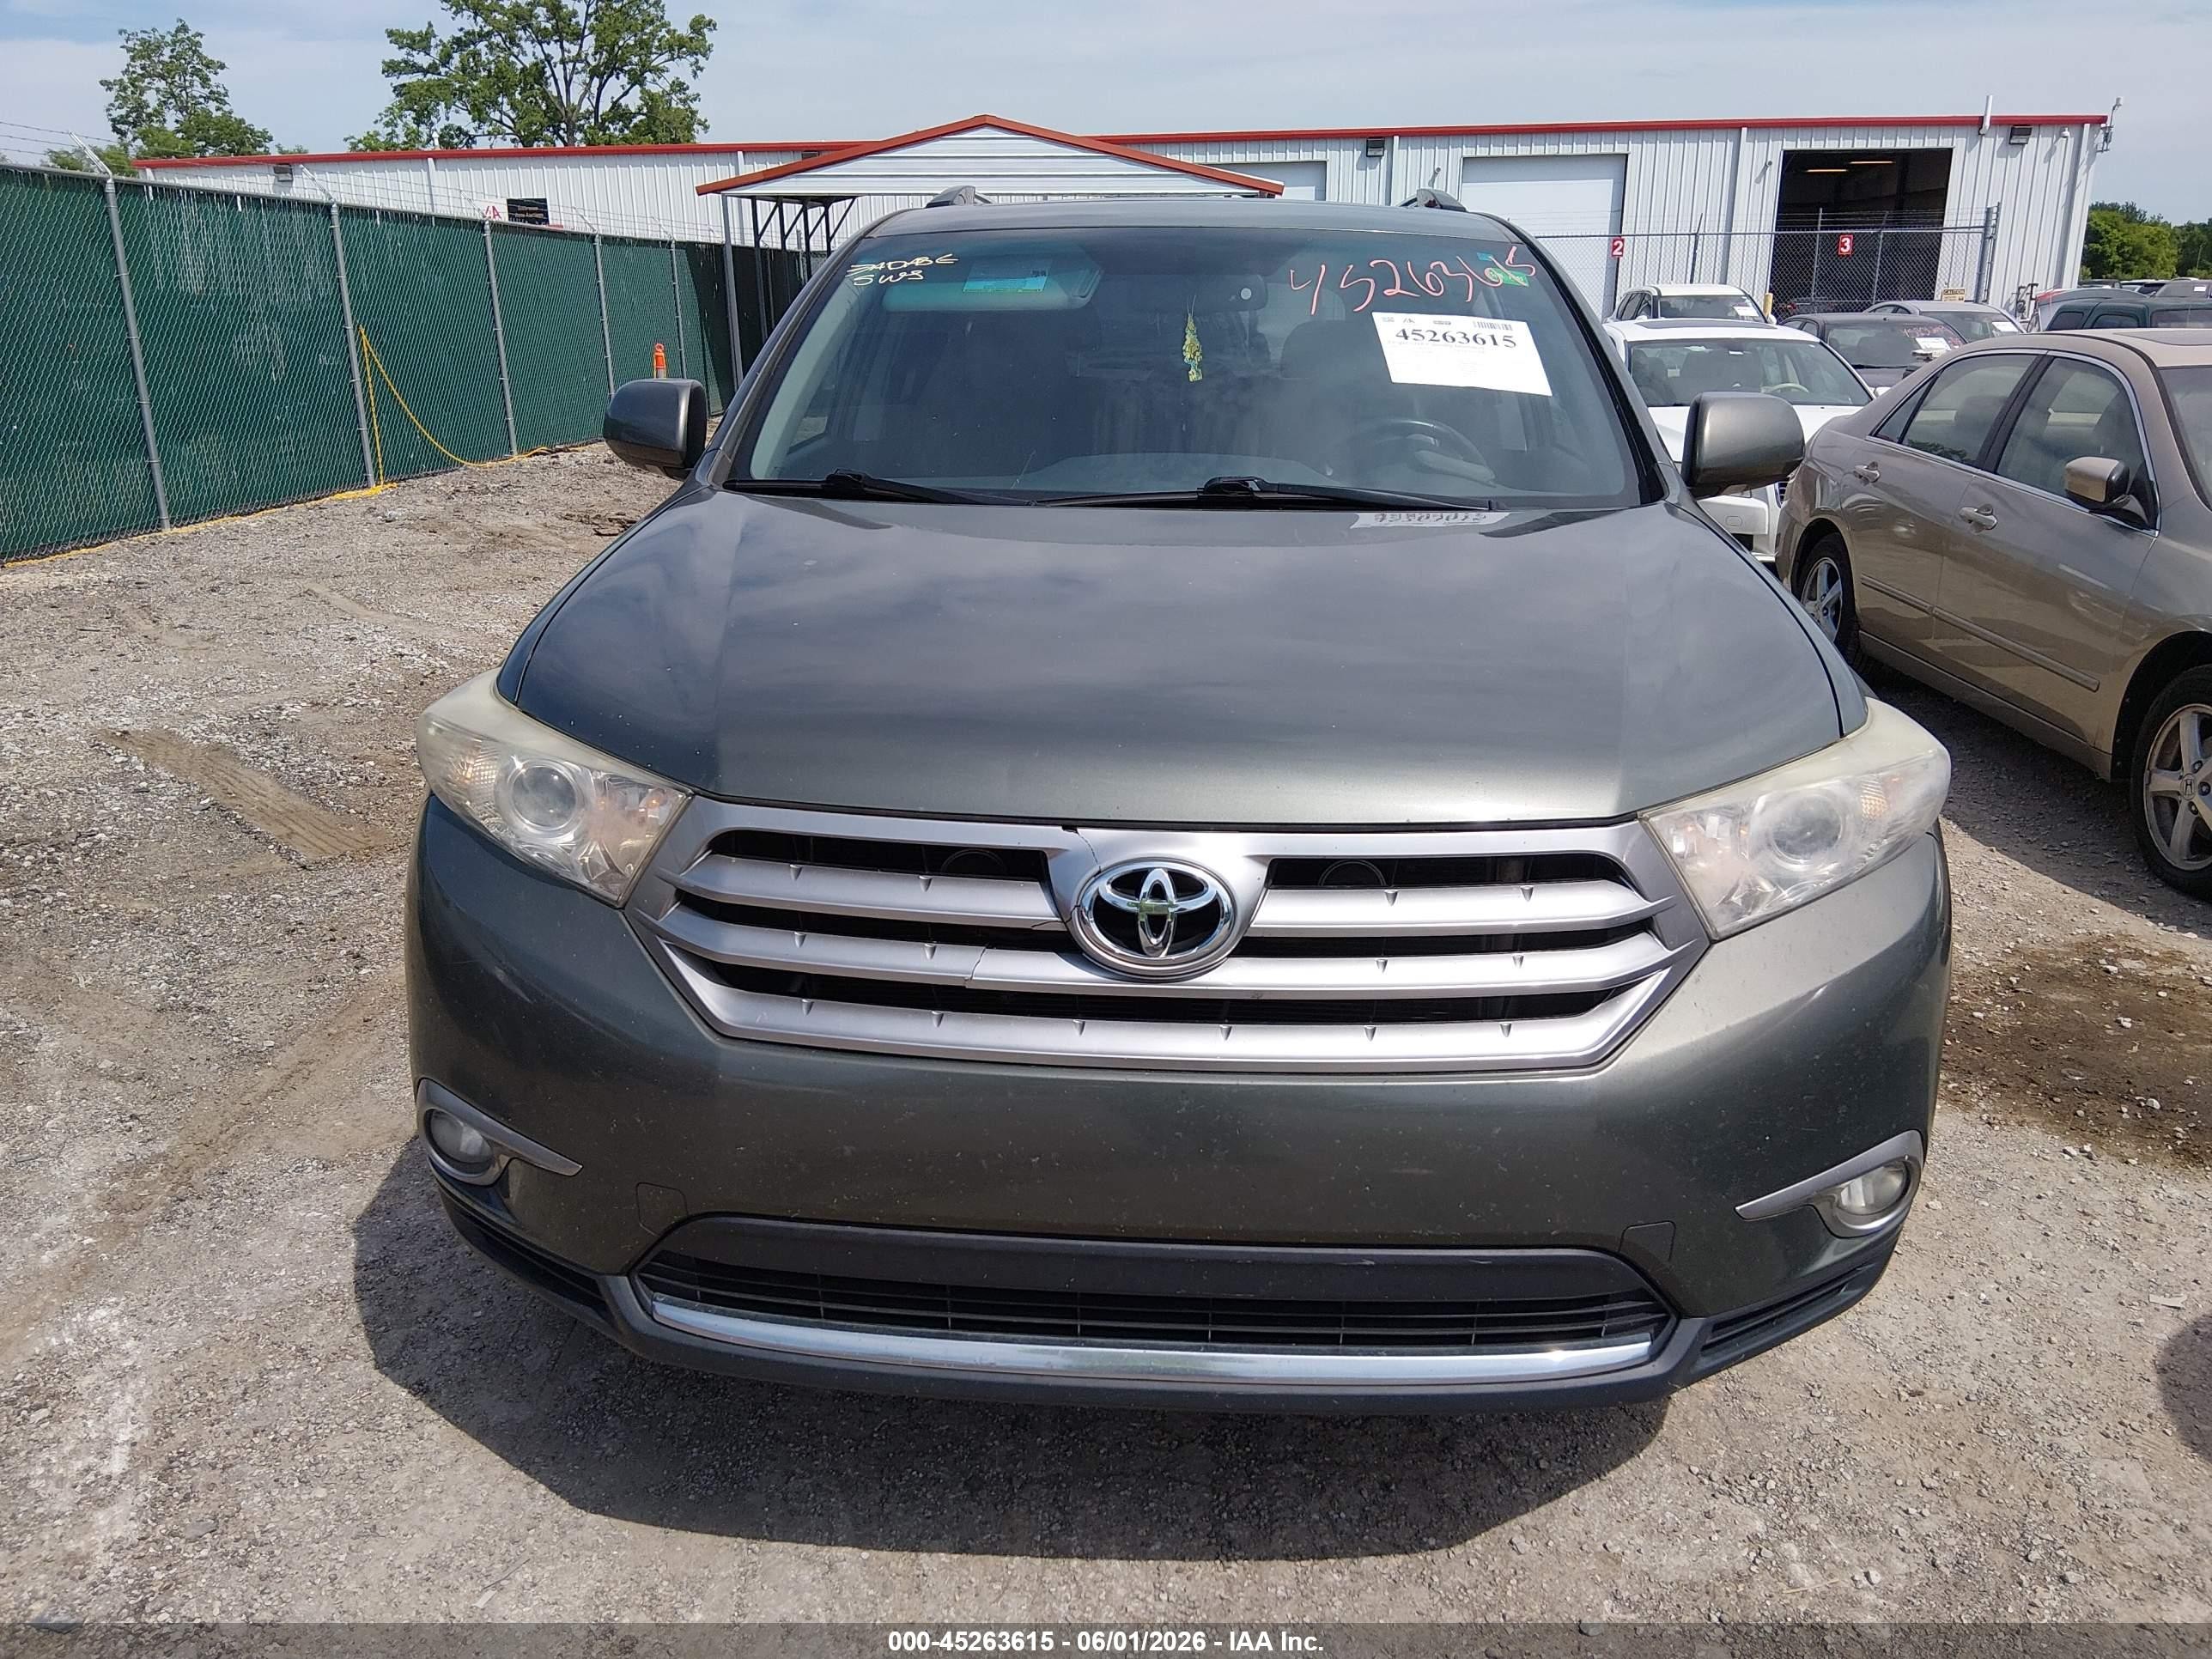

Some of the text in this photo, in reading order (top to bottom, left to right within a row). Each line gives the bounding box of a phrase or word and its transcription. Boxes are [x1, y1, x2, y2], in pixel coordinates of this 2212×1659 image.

[1613, 240, 1624, 256] 2
[1840, 237, 1850, 252] 3
[1395, 328, 1516, 349] 45263615
